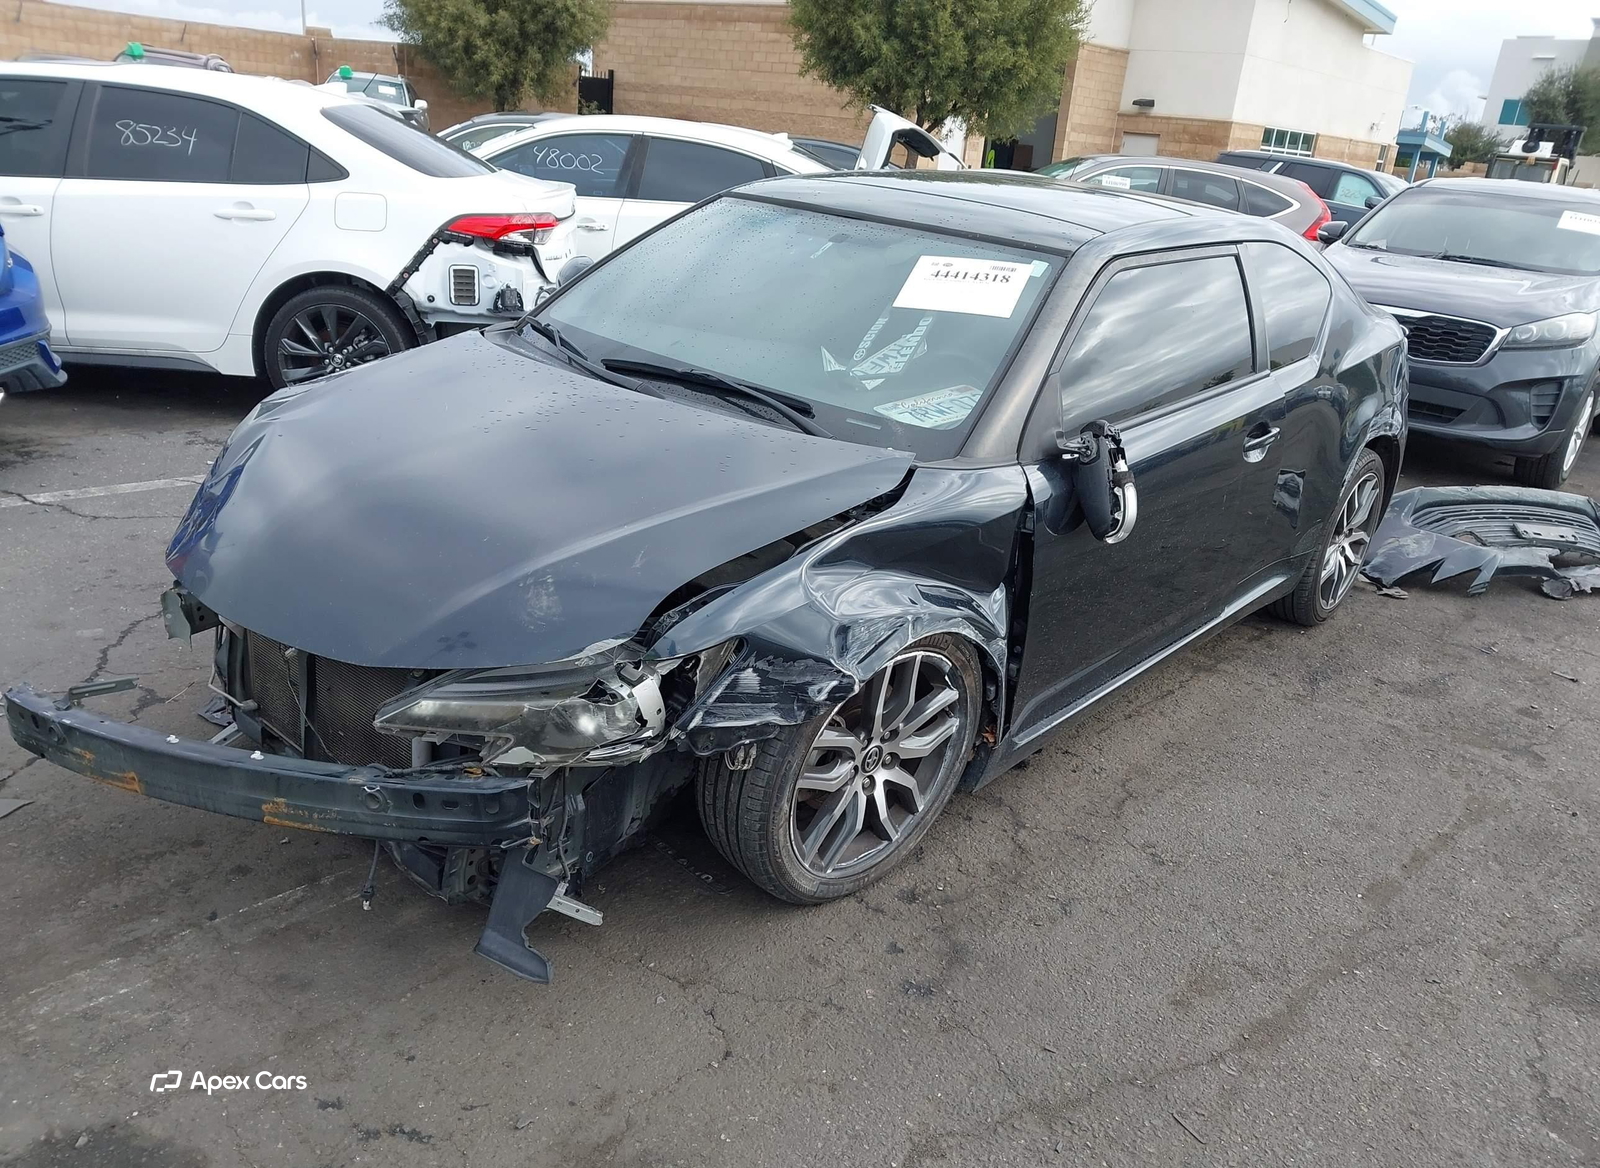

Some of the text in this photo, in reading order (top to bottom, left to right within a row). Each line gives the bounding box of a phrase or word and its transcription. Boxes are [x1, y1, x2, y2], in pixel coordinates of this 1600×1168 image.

[115, 119, 198, 156] 85234
[533, 146, 605, 175] 48002
[930, 270, 1012, 284] 44414318
